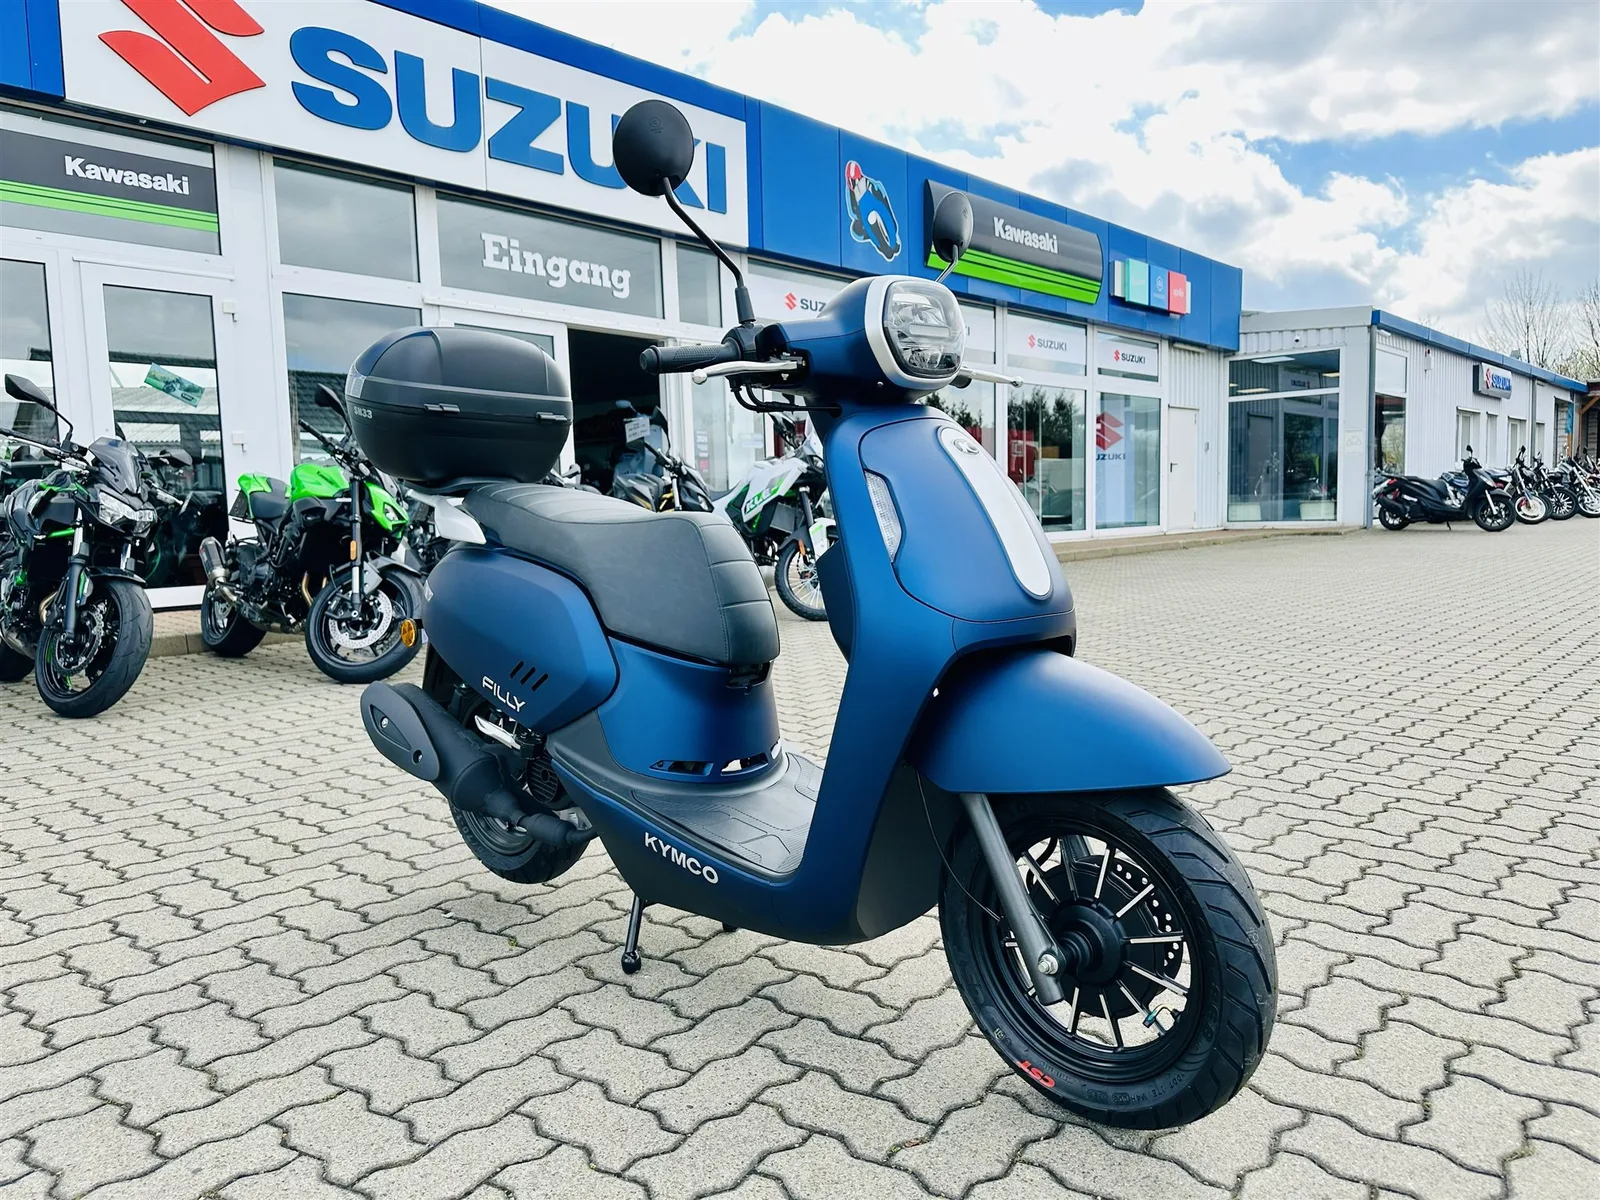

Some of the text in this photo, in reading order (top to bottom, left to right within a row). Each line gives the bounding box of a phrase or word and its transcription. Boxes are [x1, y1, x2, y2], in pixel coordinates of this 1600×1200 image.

[290, 26, 727, 215] SUZUI
[64, 155, 190, 195] Kawasaki
[993, 216, 1059, 254] Kawasaki
[481, 232, 631, 299] Eingang
[1037, 339, 1067, 351] SUZUKI
[1121, 353, 1146, 364] SUZUKI
[482, 675, 526, 713] FILLY
[644, 831, 719, 884] KYMCO
[1017, 1061, 1055, 1088] CST
